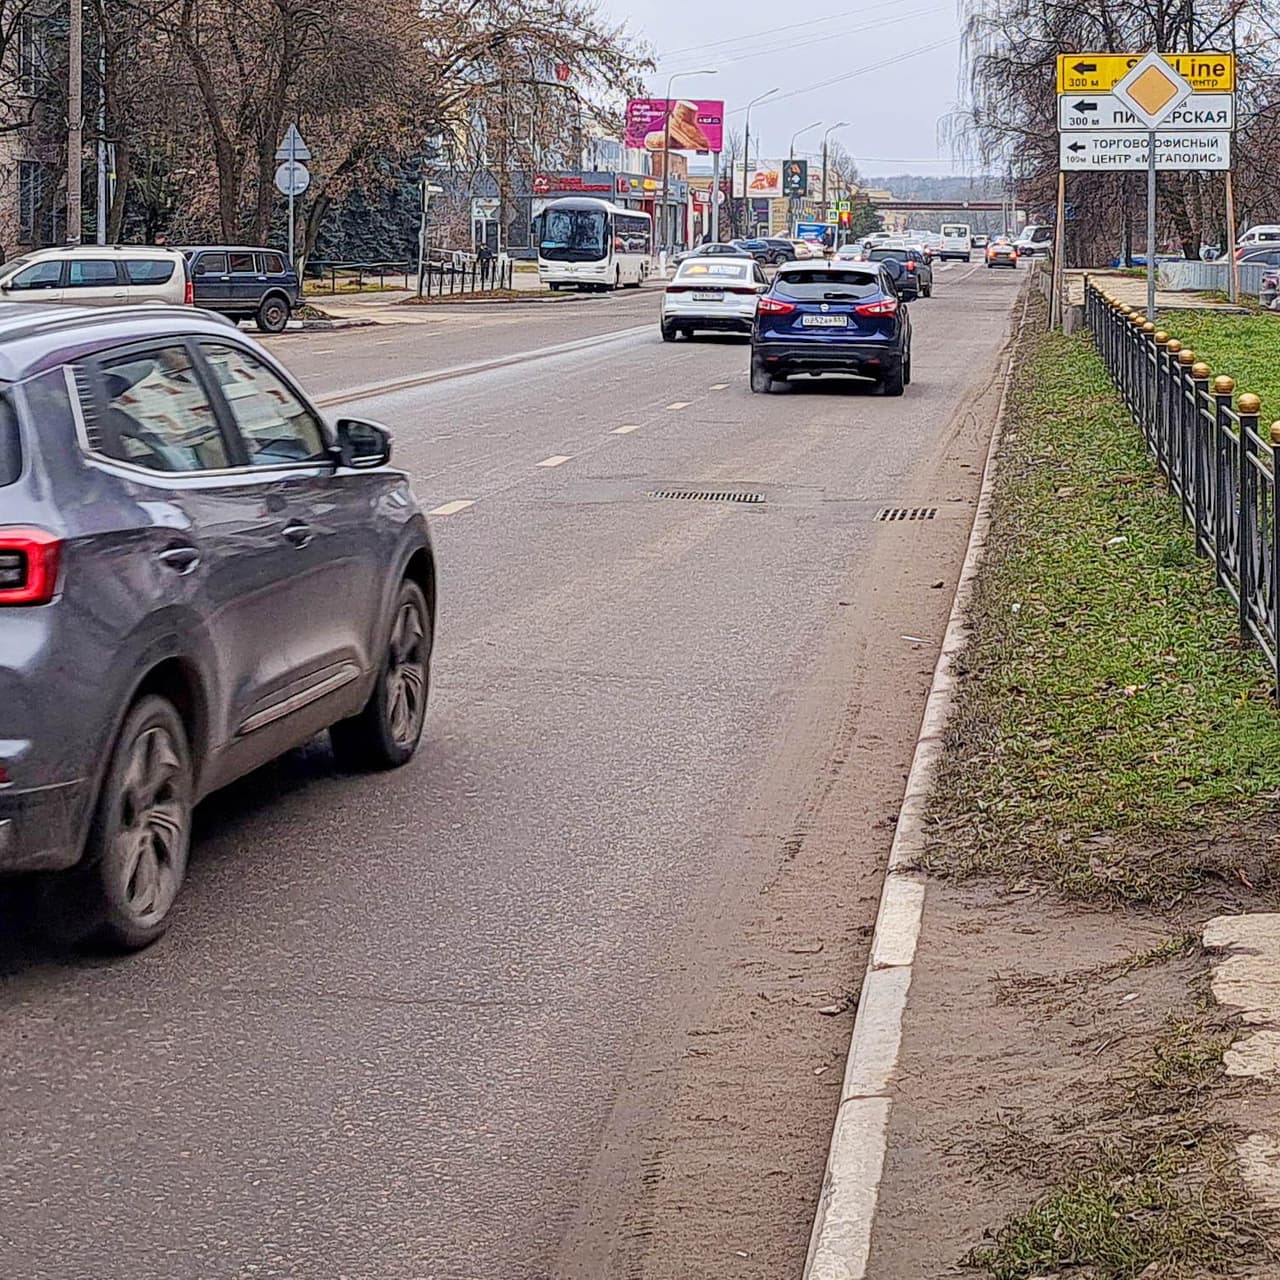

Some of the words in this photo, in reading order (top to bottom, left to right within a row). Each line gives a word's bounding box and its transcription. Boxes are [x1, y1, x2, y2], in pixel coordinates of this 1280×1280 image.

[1068, 78, 1088, 87] 300
[1069, 116, 1088, 126] 300
[1092, 154, 1132, 165] ЦЕНТР
